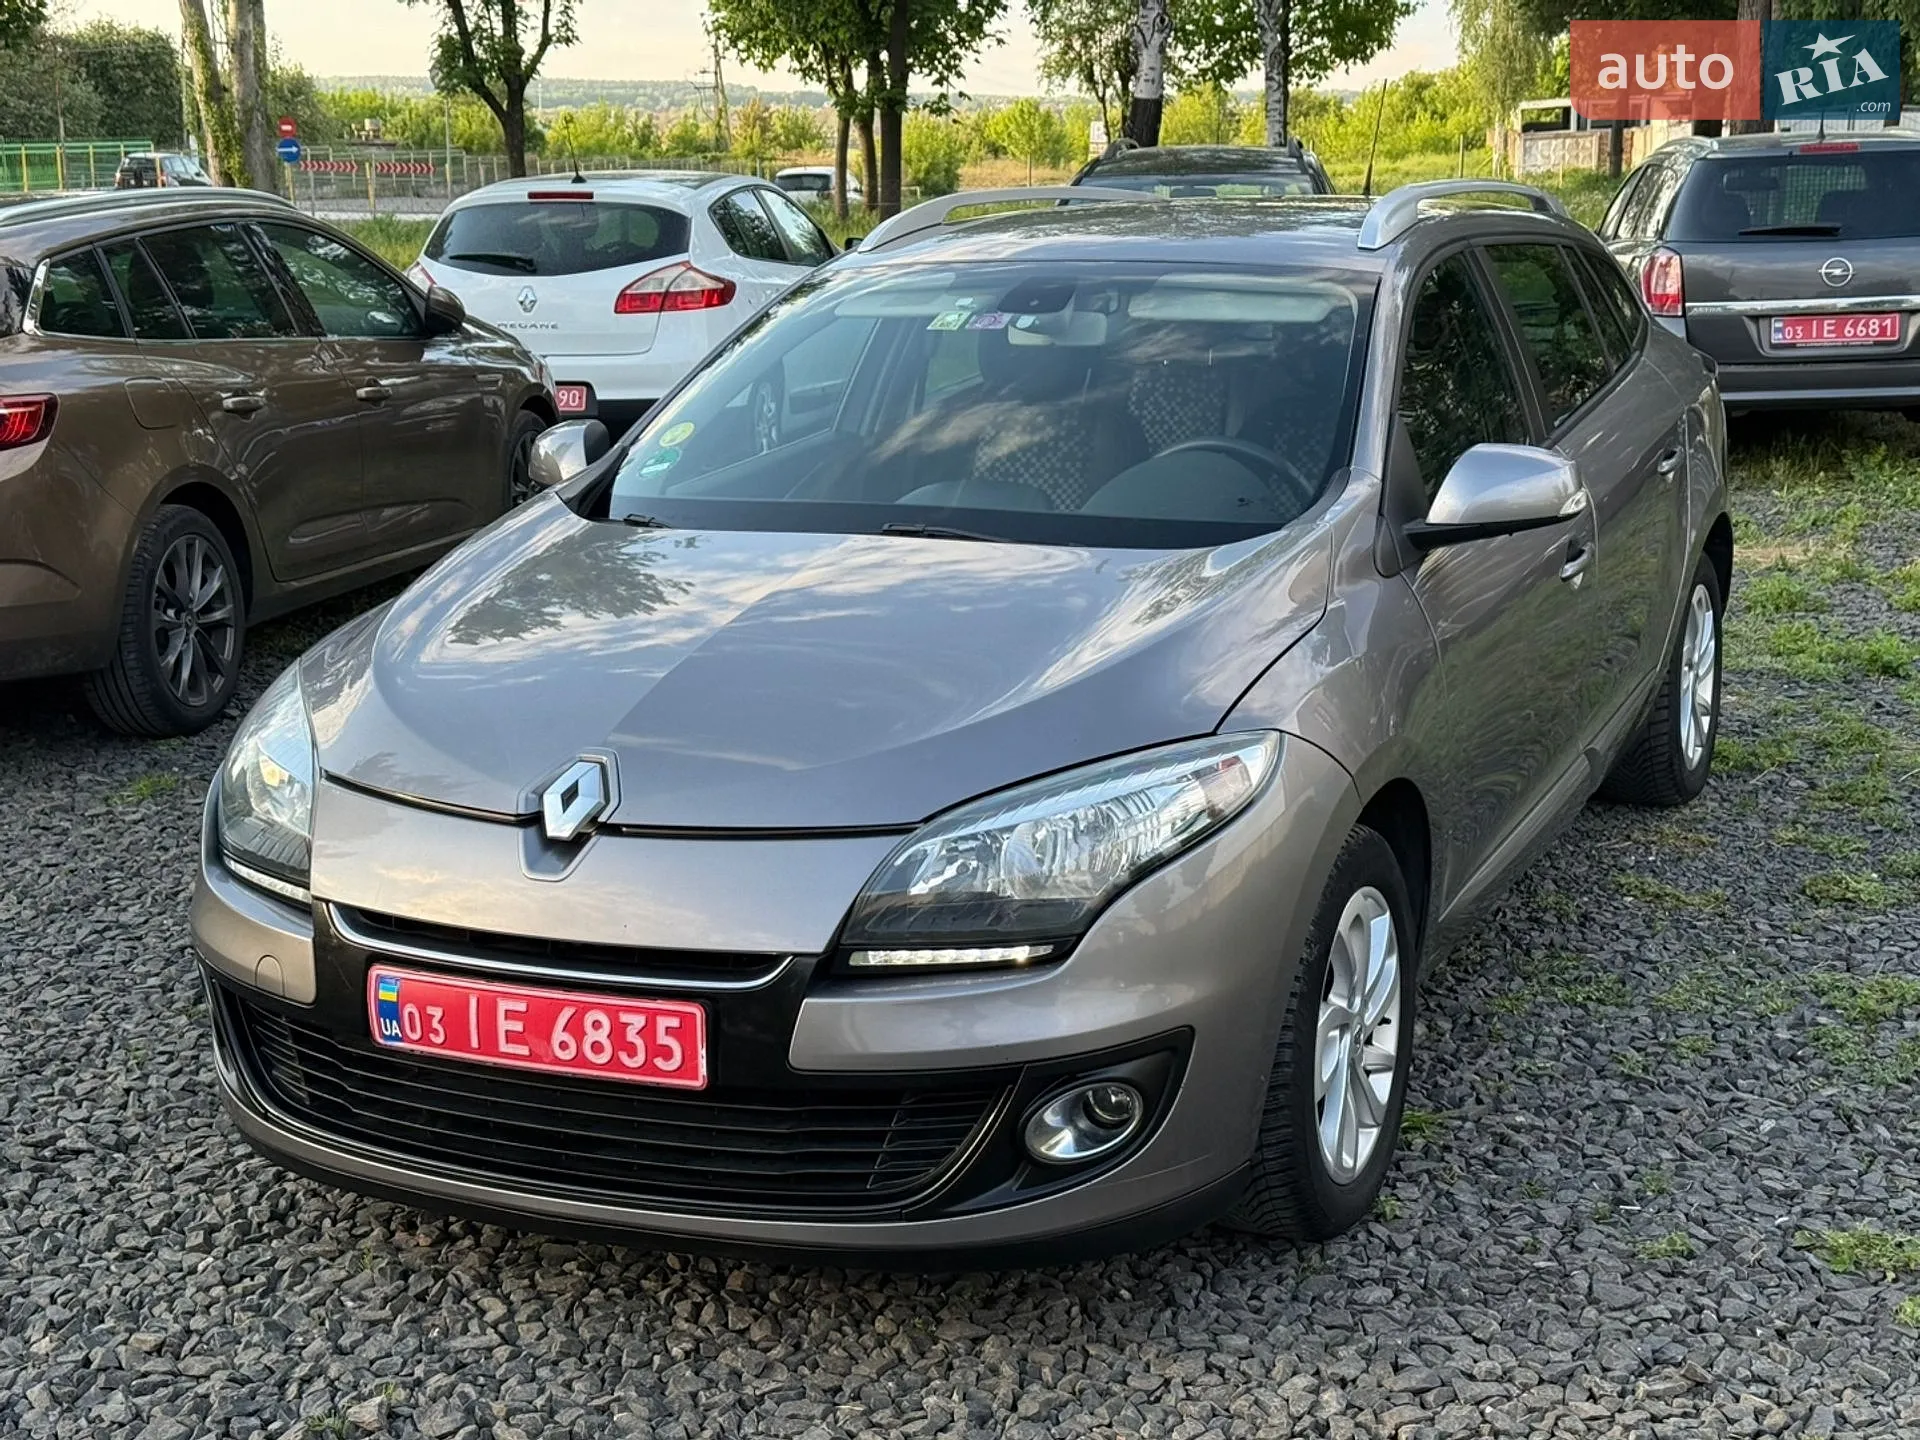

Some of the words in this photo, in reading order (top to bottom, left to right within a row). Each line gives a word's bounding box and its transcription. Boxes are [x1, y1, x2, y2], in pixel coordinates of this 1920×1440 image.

[1785, 326, 1804, 339] 03
[1812, 319, 1837, 338] IE
[1843, 318, 1893, 337] 6681
[380, 1017, 403, 1038] UA
[402, 1002, 447, 1045] 03
[468, 993, 531, 1056] IE
[550, 1005, 684, 1072] 6835
